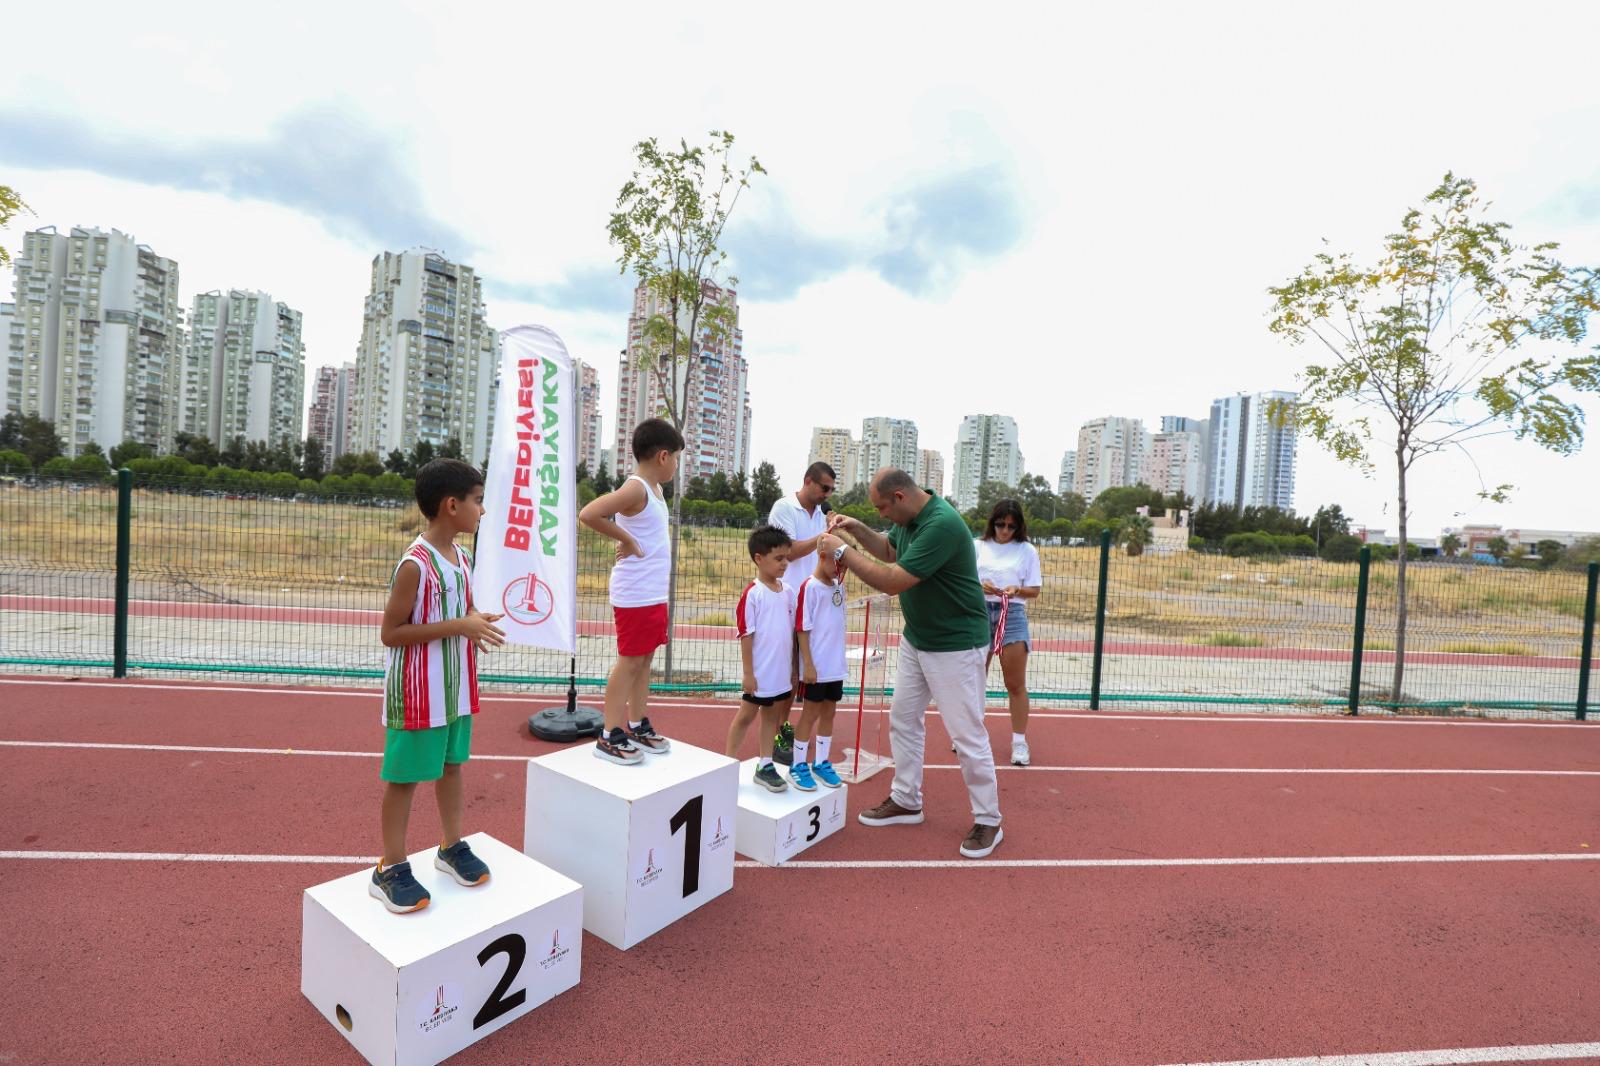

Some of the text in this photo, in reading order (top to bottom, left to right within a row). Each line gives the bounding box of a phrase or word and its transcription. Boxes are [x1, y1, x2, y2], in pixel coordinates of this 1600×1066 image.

[669, 794, 704, 898] 1
[806, 805, 821, 842] 3
[473, 933, 527, 1031] 2
